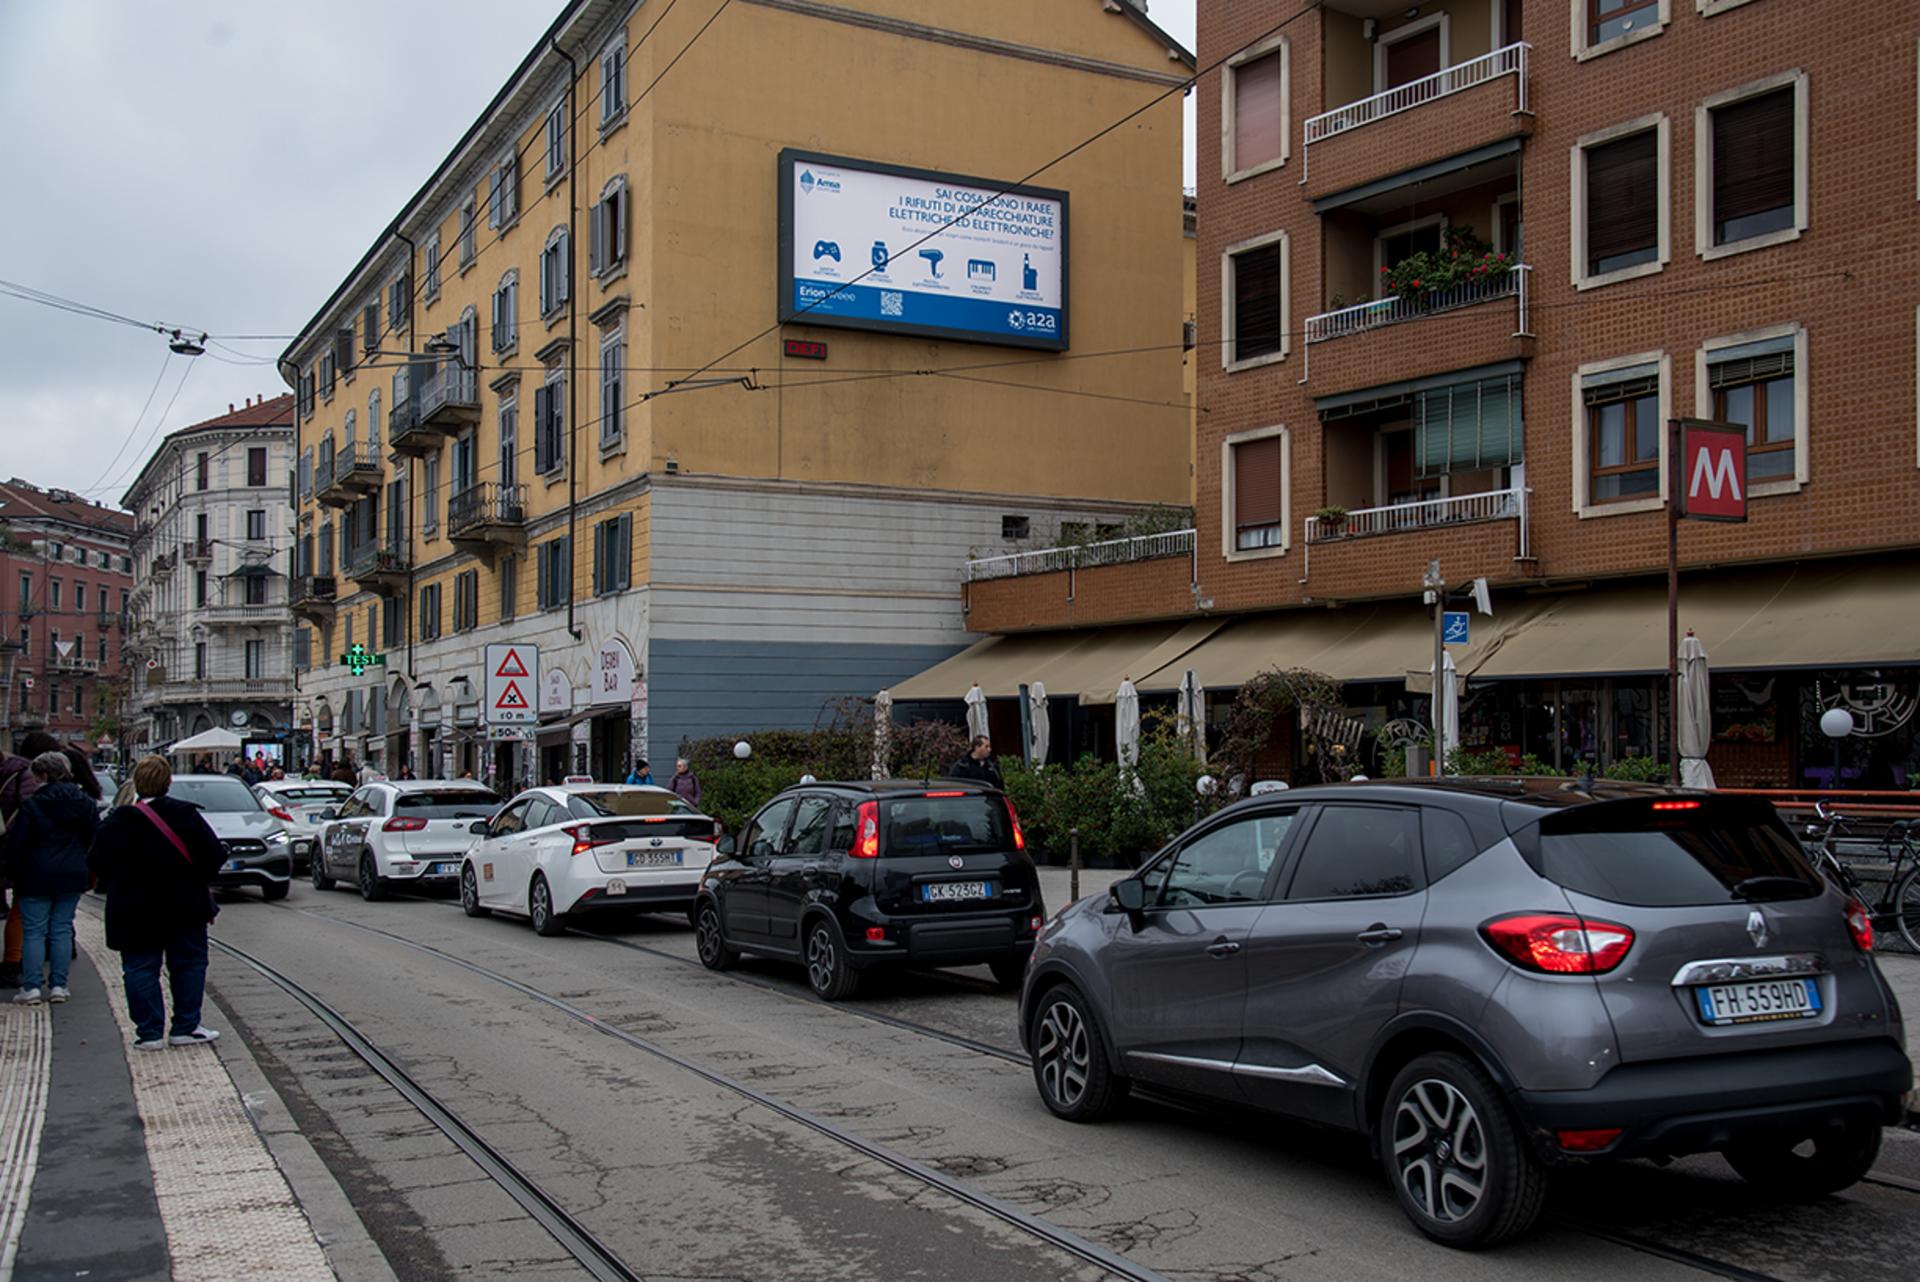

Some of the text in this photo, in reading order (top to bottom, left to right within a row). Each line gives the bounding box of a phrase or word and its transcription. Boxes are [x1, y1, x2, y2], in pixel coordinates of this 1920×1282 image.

[905, 197, 942, 211] RIFIUTI
[944, 202, 956, 213] DI
[935, 188, 951, 199] SAI
[954, 191, 983, 203] COSA
[986, 195, 1018, 209] SONO
[889, 207, 952, 224] ELETTRICHE
[956, 217, 970, 228] ED
[972, 219, 1054, 240] ELETTRONICHE?
[1026, 312, 1056, 328] a2a
[1689, 446, 1742, 501] M
[345, 655, 376, 665] TEST
[603, 672, 618, 692] BAR
[1711, 982, 1806, 1015] FH 559HD
